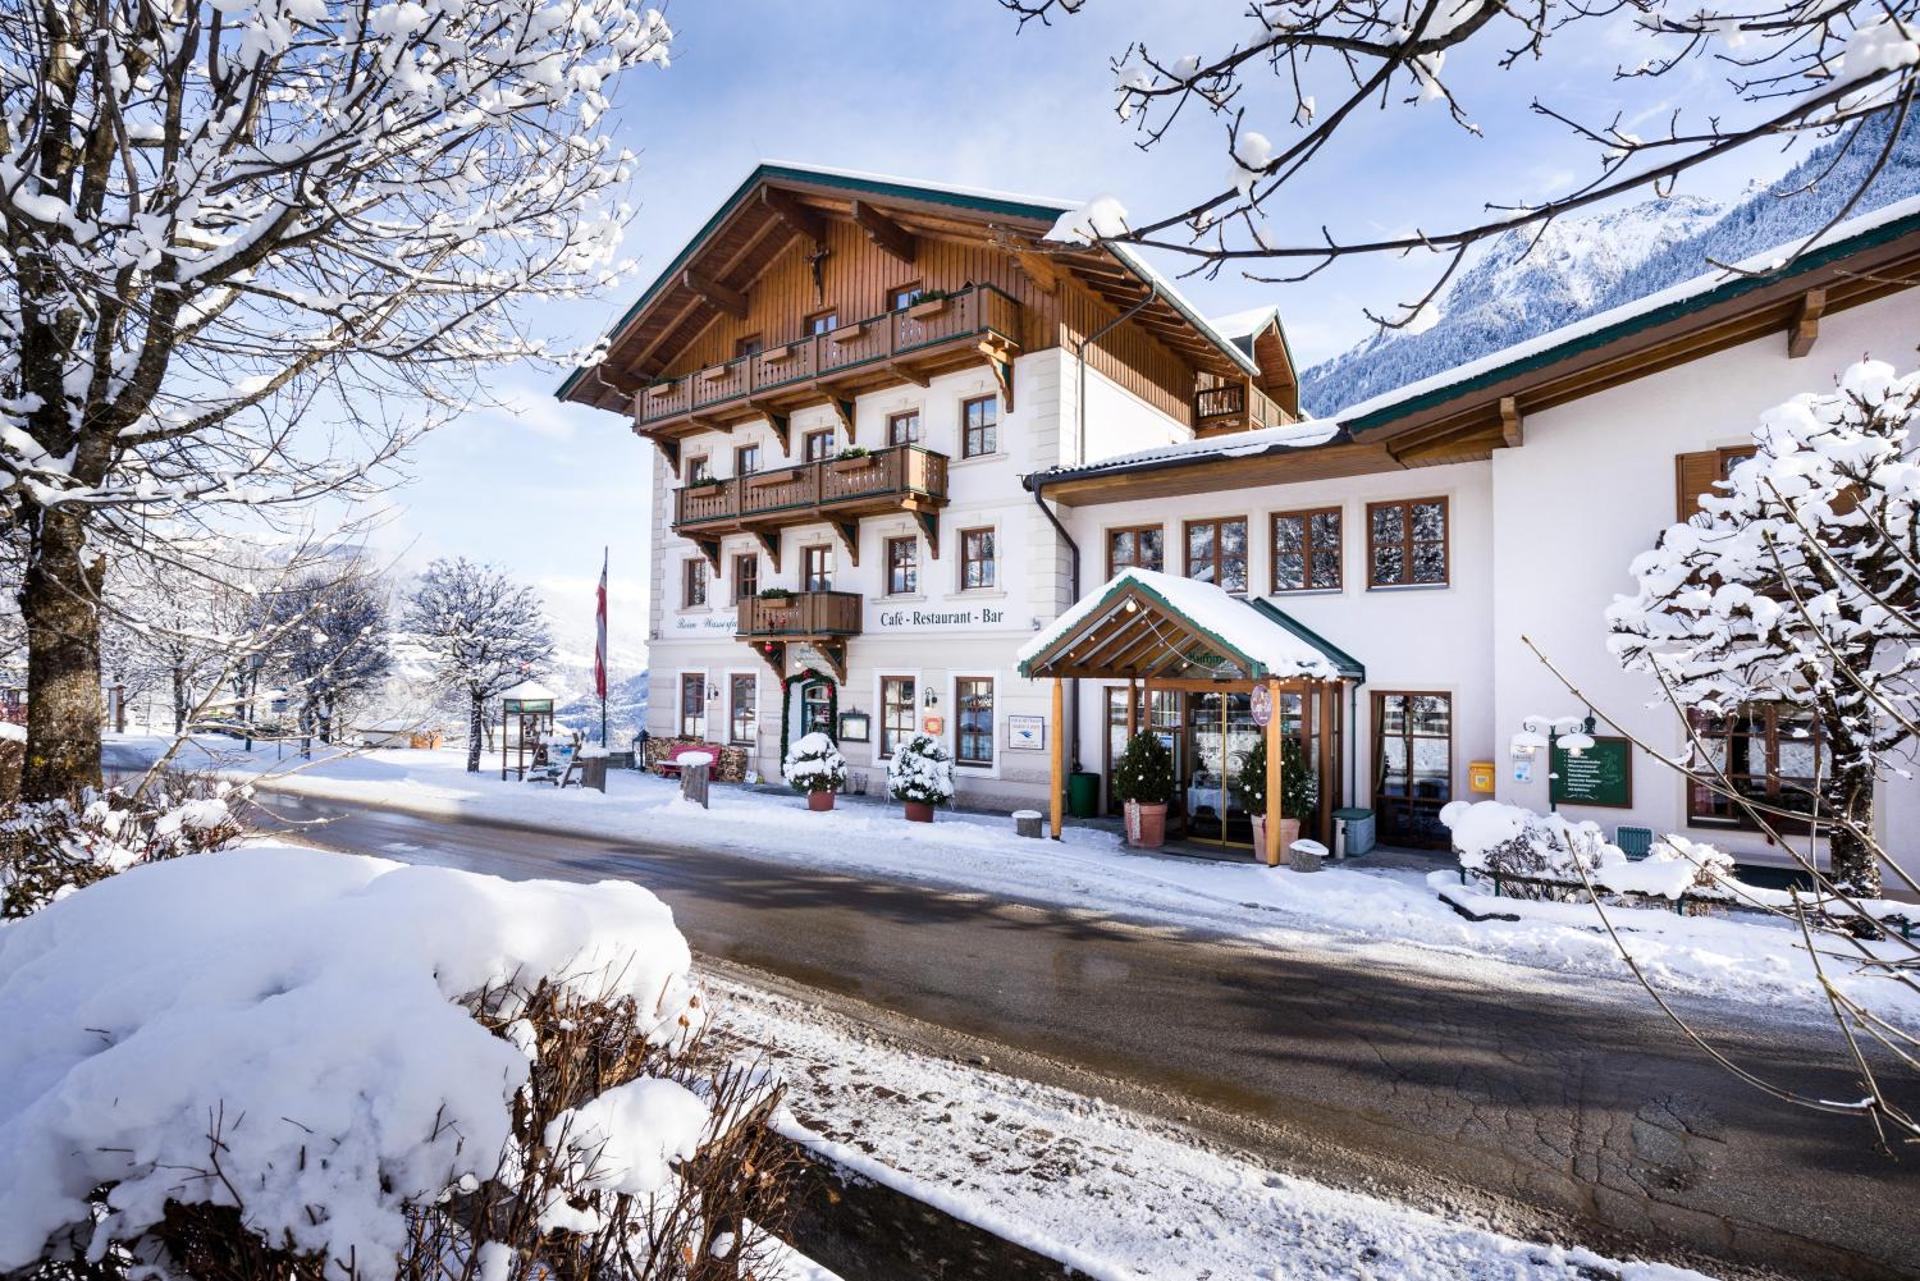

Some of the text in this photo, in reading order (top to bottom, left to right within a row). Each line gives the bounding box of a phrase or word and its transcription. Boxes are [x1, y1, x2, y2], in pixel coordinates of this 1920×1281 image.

[880, 611, 903, 626] Café
[913, 610, 971, 625] Restaurant
[983, 608, 1004, 623] Bar
